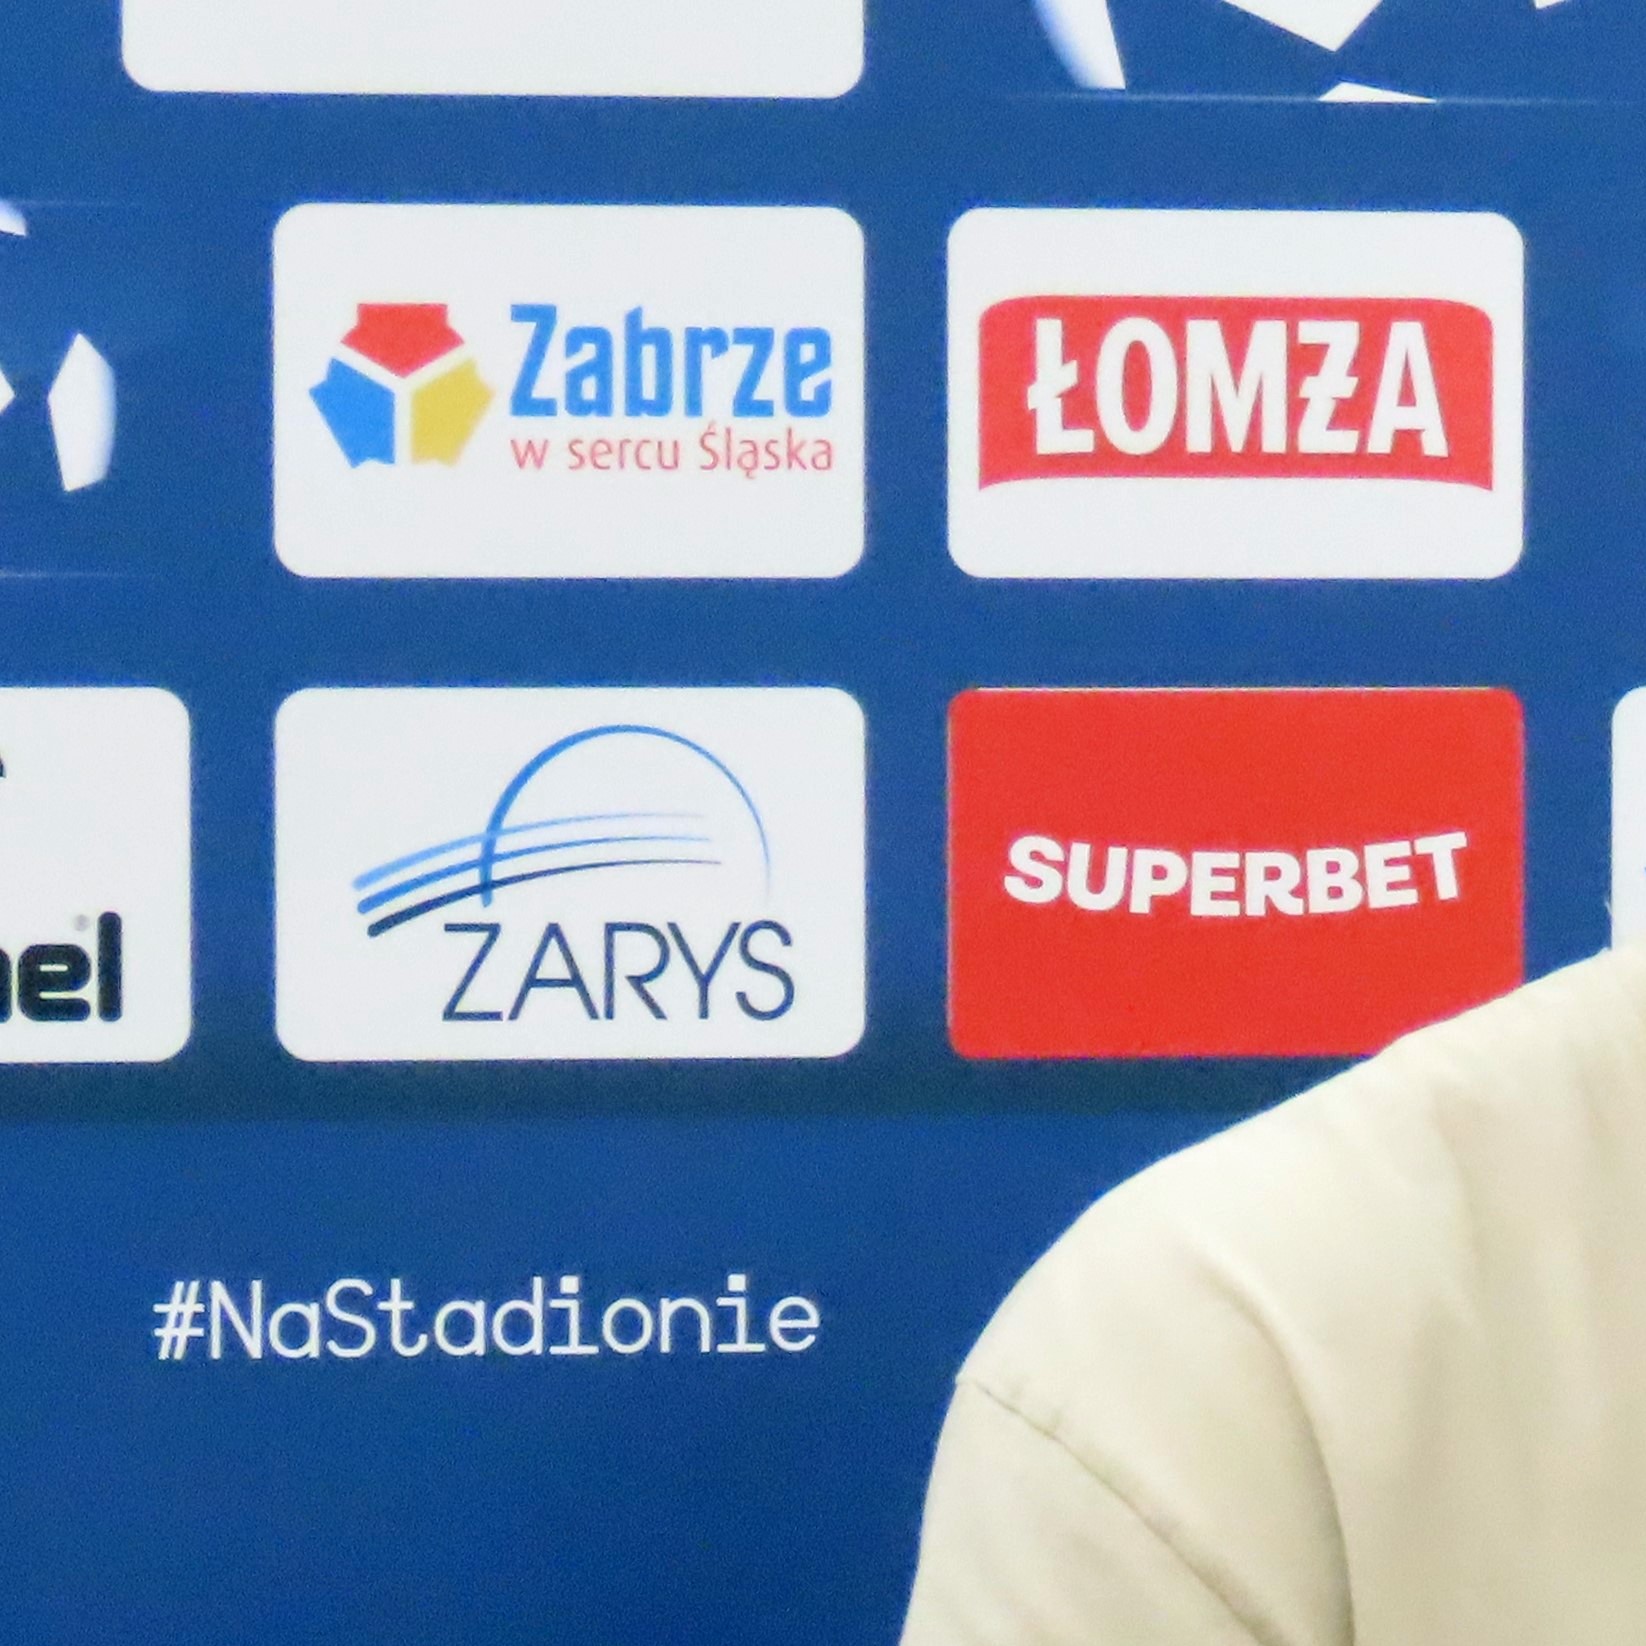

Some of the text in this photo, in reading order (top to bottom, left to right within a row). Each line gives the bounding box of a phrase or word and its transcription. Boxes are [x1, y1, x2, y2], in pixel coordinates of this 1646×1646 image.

[509, 302, 834, 418] Zabrze
[510, 421, 834, 481] w sercu Śląska
[1003, 831, 1470, 918] SUPERBET
[441, 919, 796, 1022] ZARYS
[153, 1273, 822, 1361] #NaStadionie
